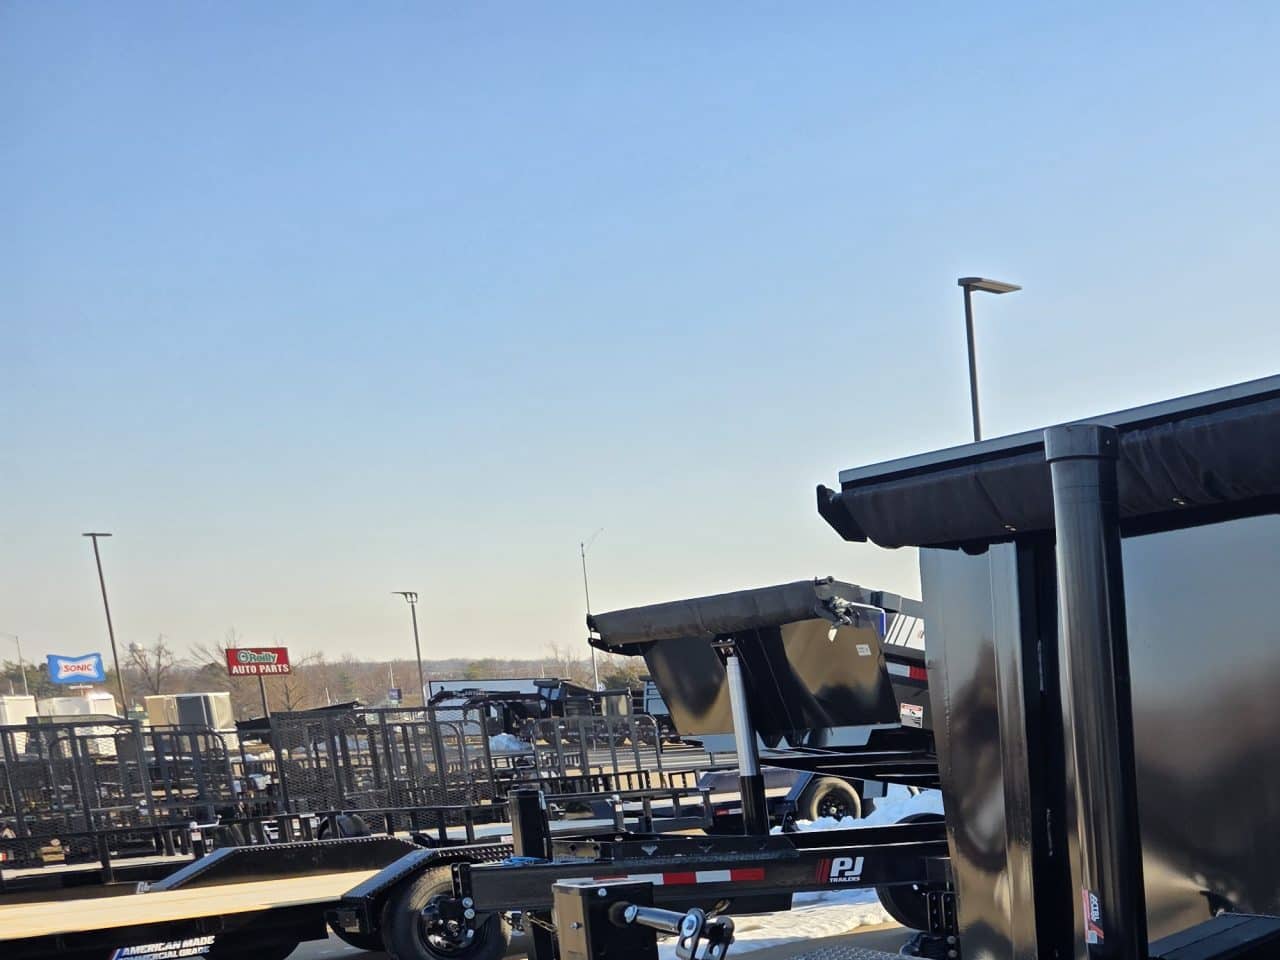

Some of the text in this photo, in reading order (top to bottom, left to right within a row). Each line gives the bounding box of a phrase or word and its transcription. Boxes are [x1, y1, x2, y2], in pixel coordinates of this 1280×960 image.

[64, 664, 93, 672] SONIC
[232, 664, 289, 674] AUTO PARTS
[830, 857, 864, 876] PJ
[123, 936, 215, 956] AMERICAN MADE
[179, 946, 210, 957] GRADE
